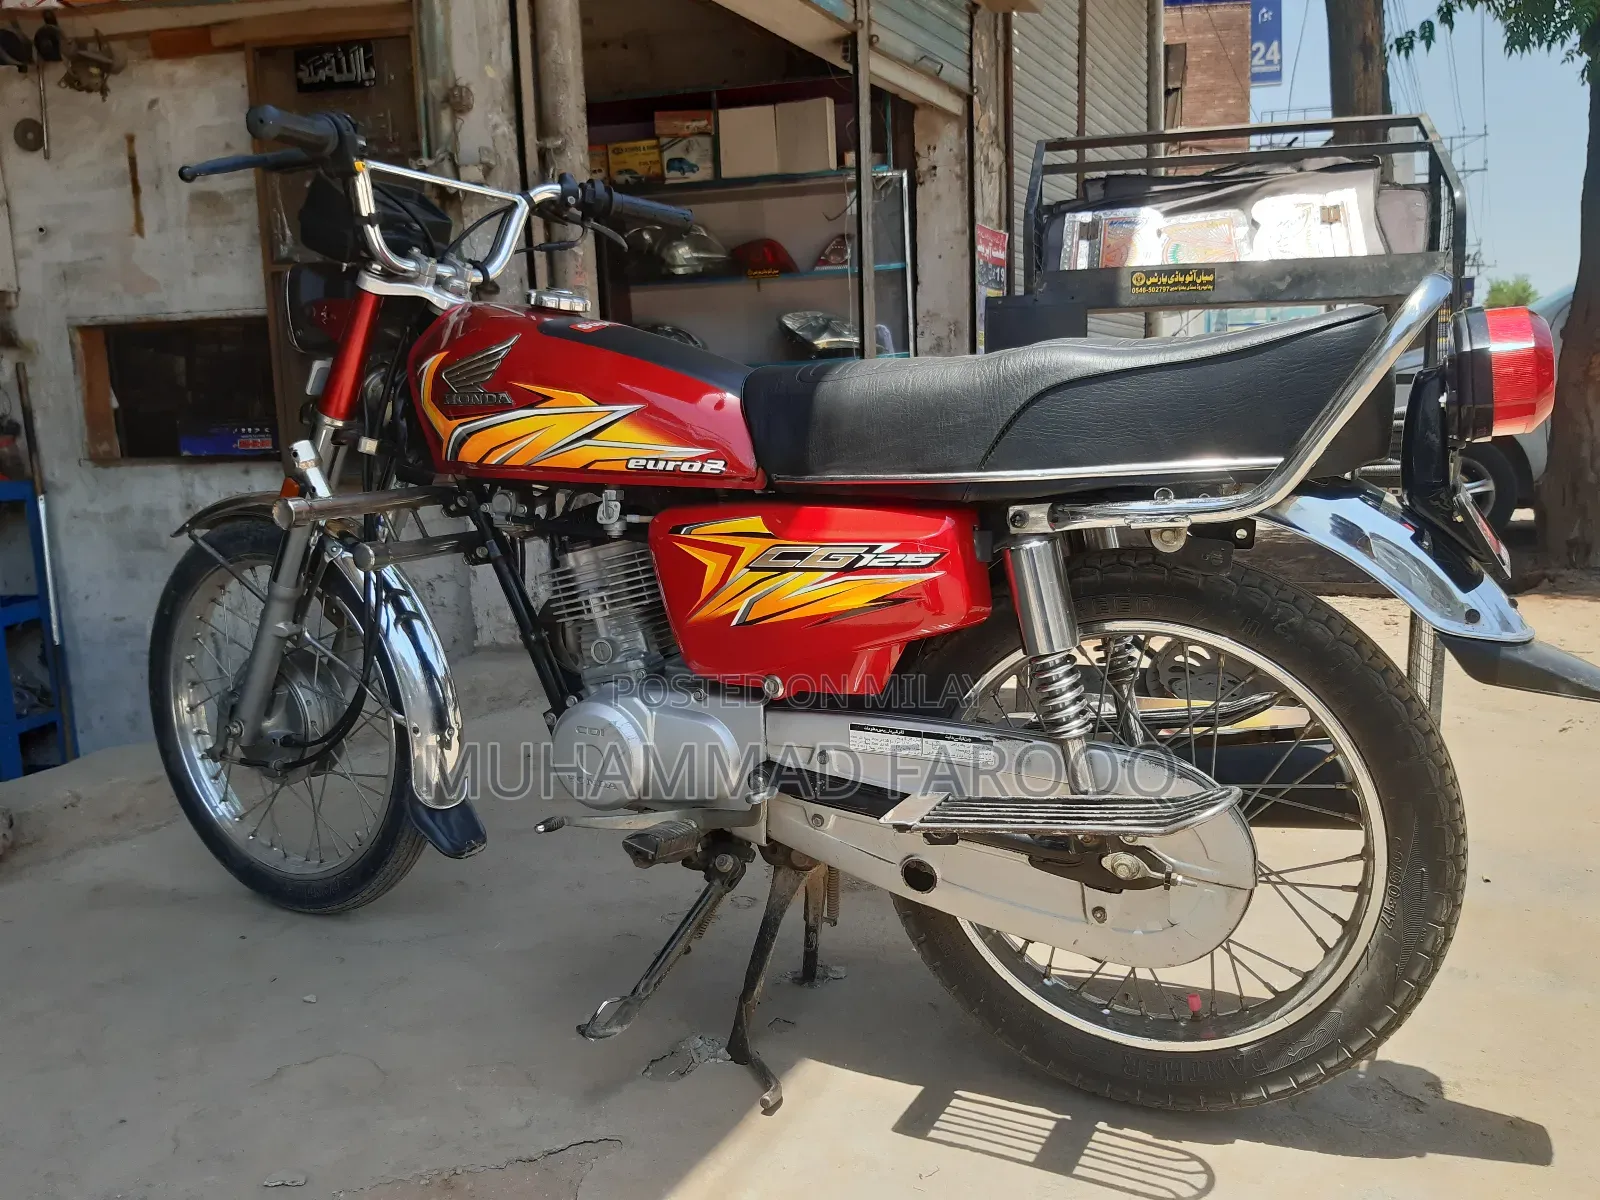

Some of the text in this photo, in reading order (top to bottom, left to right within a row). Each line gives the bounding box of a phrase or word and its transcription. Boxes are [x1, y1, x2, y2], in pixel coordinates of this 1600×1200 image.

[1251, 40, 1280, 66] 24
[444, 392, 514, 405] HONDA
[626, 457, 729, 475] euro2
